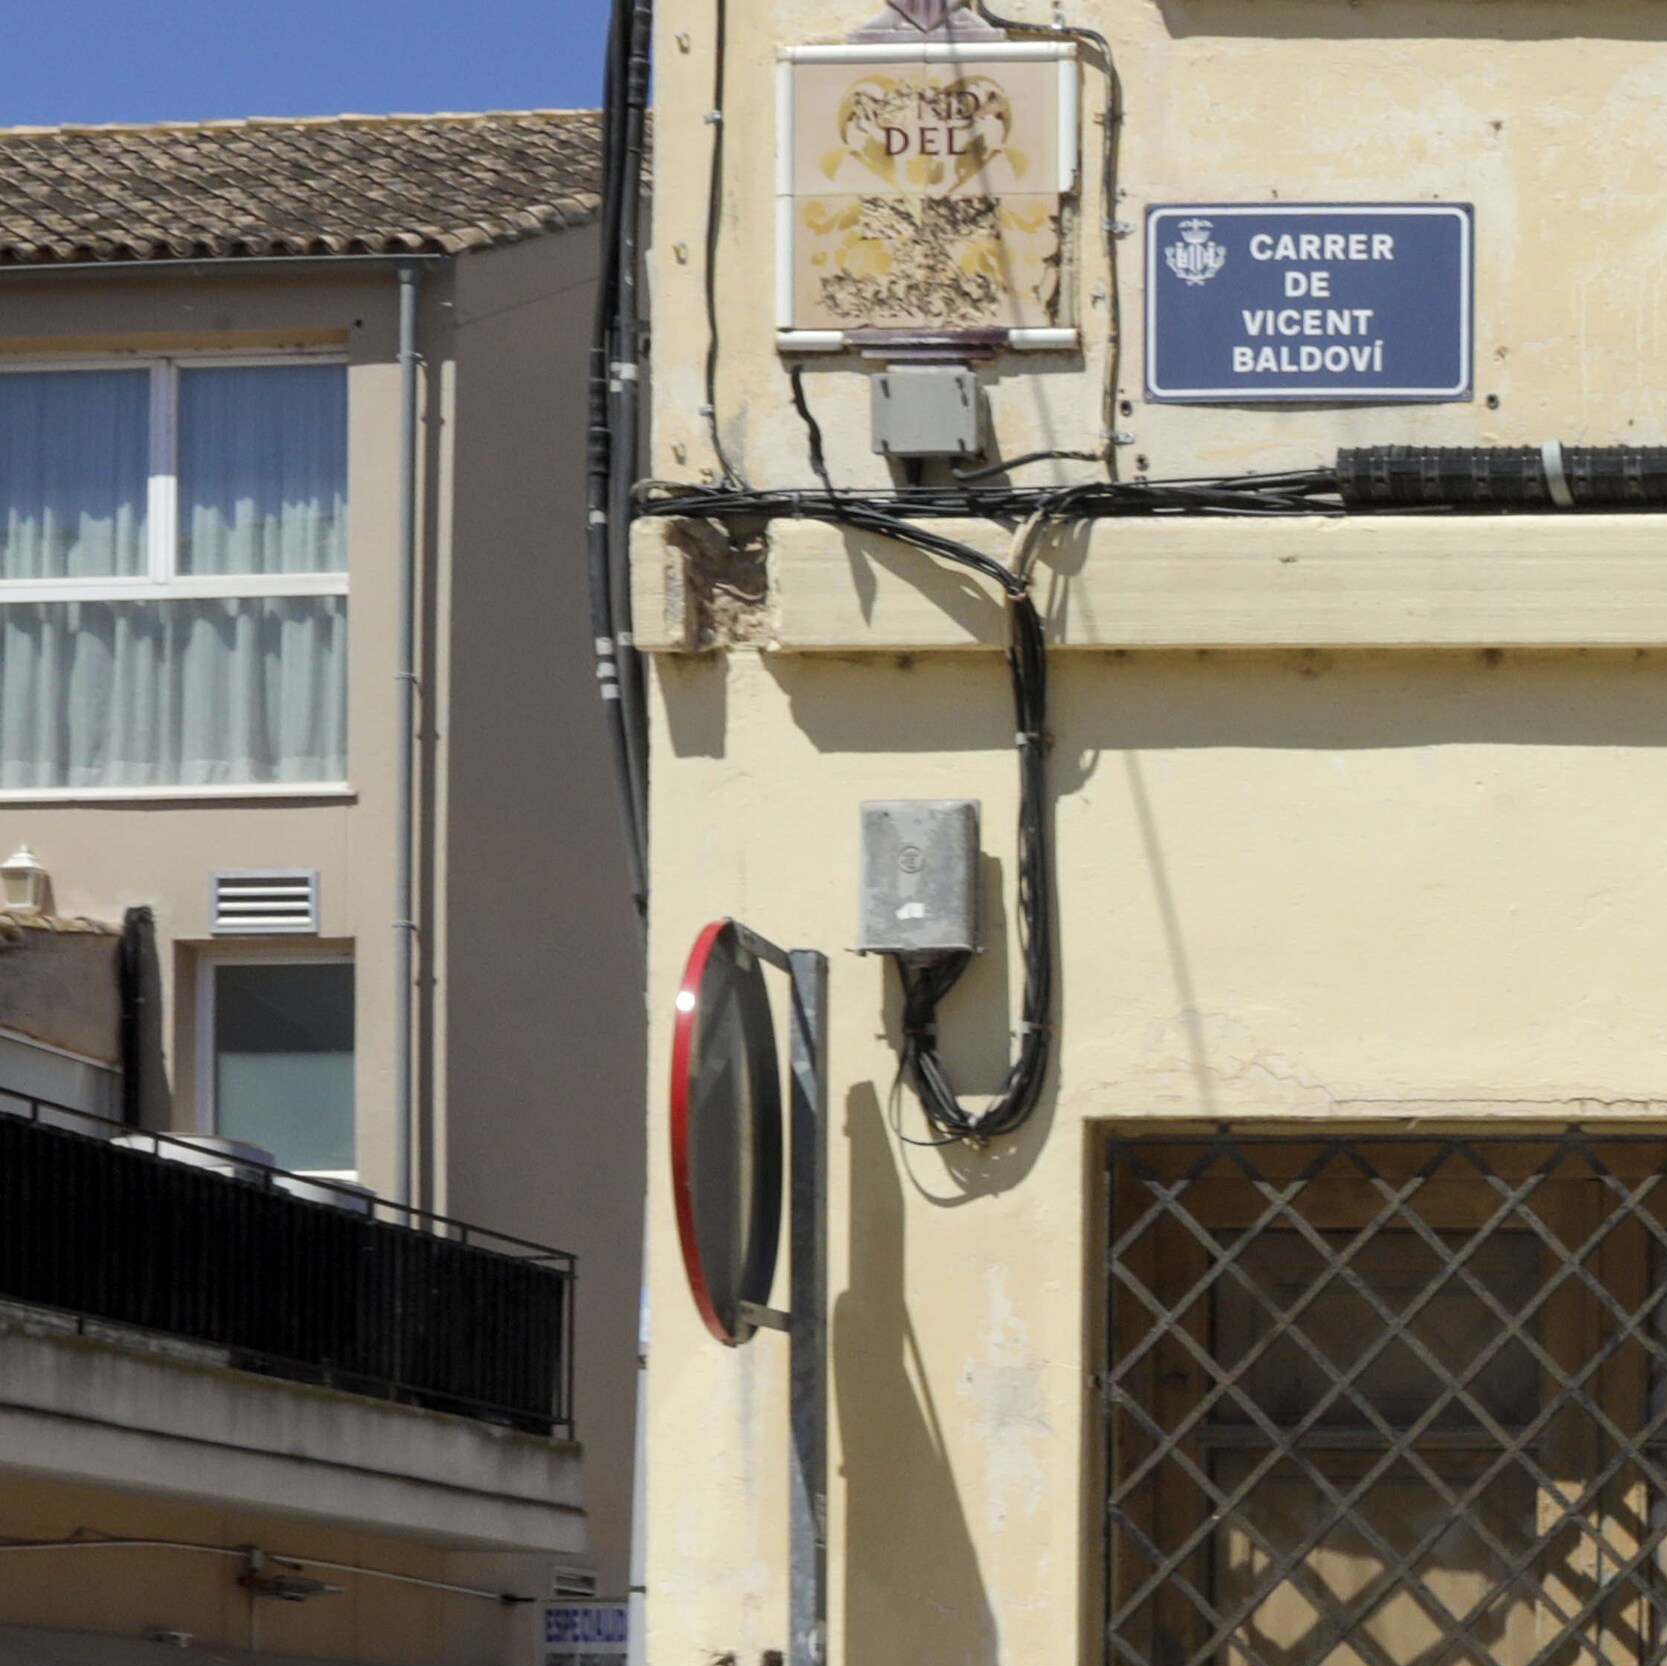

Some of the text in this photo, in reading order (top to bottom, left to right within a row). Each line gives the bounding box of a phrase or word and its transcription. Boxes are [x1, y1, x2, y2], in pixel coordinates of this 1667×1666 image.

[885, 126, 969, 156] DEL
[1249, 233, 1395, 261] CARRER
[1284, 270, 1331, 298] DE
[1242, 309, 1374, 336] VICENT
[1232, 339, 1384, 373] BALDOVÍ
